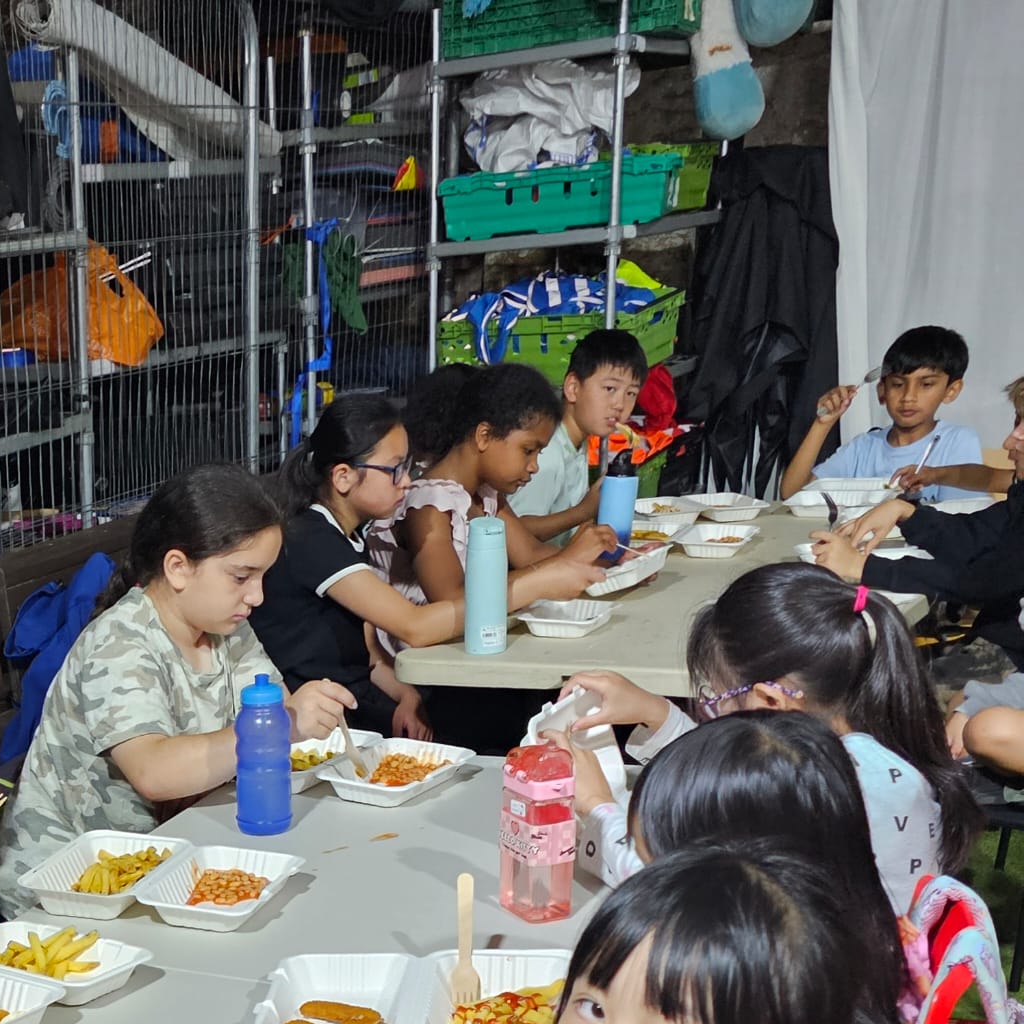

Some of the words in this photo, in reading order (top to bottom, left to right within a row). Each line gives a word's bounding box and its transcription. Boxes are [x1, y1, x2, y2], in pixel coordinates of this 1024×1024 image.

[888, 768, 902, 783] P
[894, 815, 908, 832] V
[928, 822, 935, 839] E
[909, 858, 922, 874] P
